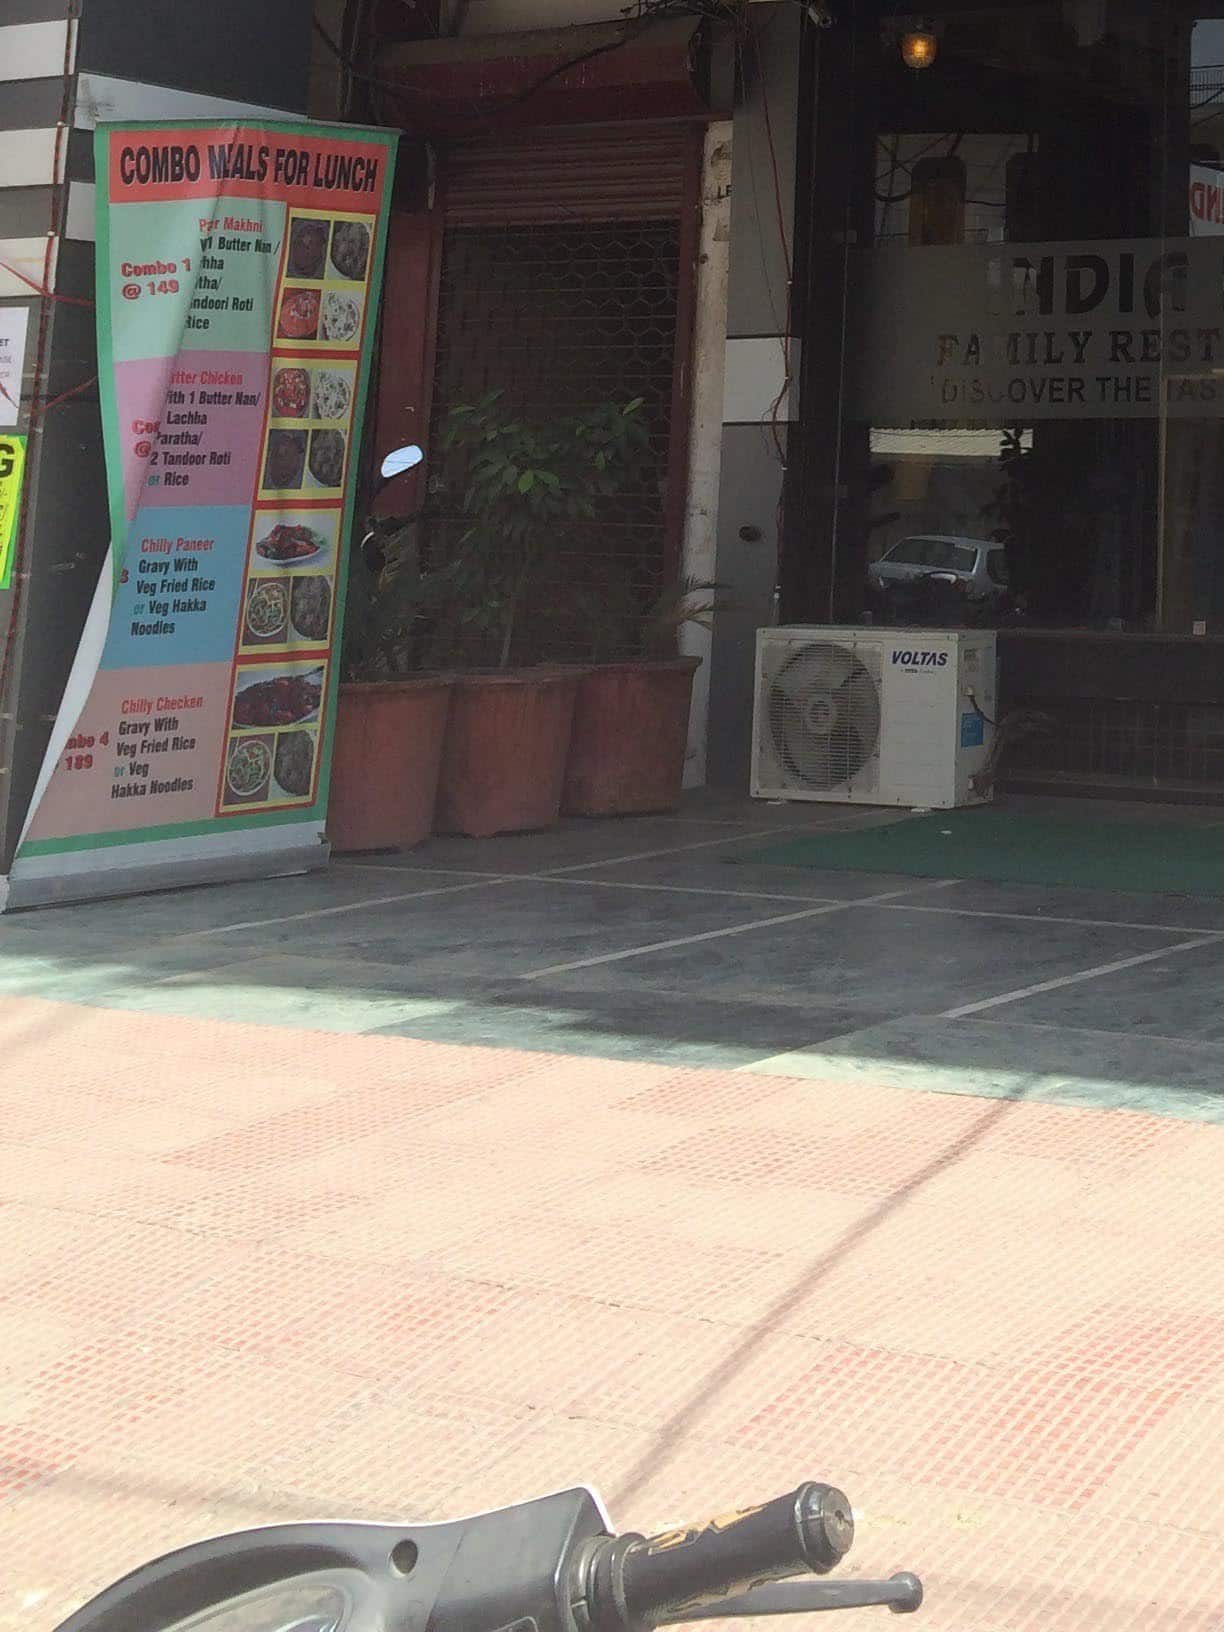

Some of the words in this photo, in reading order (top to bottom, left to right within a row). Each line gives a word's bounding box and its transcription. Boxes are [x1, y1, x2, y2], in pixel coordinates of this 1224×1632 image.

[120, 144, 201, 186] COMBO
[273, 148, 309, 186] FOR
[313, 152, 379, 193] LUNCH
[218, 236, 252, 252] Butter
[121, 260, 177, 278] Combo
[182, 258, 191, 272] 1
[232, 296, 254, 312] Roti
[200, 370, 243, 386] Chicken
[199, 390, 233, 406] Butter
[1096, 377, 1152, 403] THE
[150, 451, 159, 466] 2
[208, 451, 232, 466] Roti
[164, 471, 190, 486] Rice
[141, 537, 174, 555] Chilly
[175, 536, 215, 552] Paneer
[138, 559, 170, 575] Gravy
[174, 557, 199, 572] With
[136, 579, 158, 596] Veg
[160, 577, 189, 594] Fried
[191, 577, 216, 593] Rice
[149, 600, 170, 617] Veg
[172, 598, 207, 614] Hakka
[131, 620, 176, 637] Noodles
[892, 650, 948, 667] VOLTAS
[121, 698, 153, 715] Chilly
[118, 720, 151, 737] Gravy
[154, 717, 179, 733] With
[116, 741, 137, 758] Veg
[140, 739, 168, 754] Fried
[171, 736, 196, 751] Rice
[129, 761, 150, 778] Veg
[111, 783, 147, 800] Hakka
[149, 777, 194, 795] Noodles
